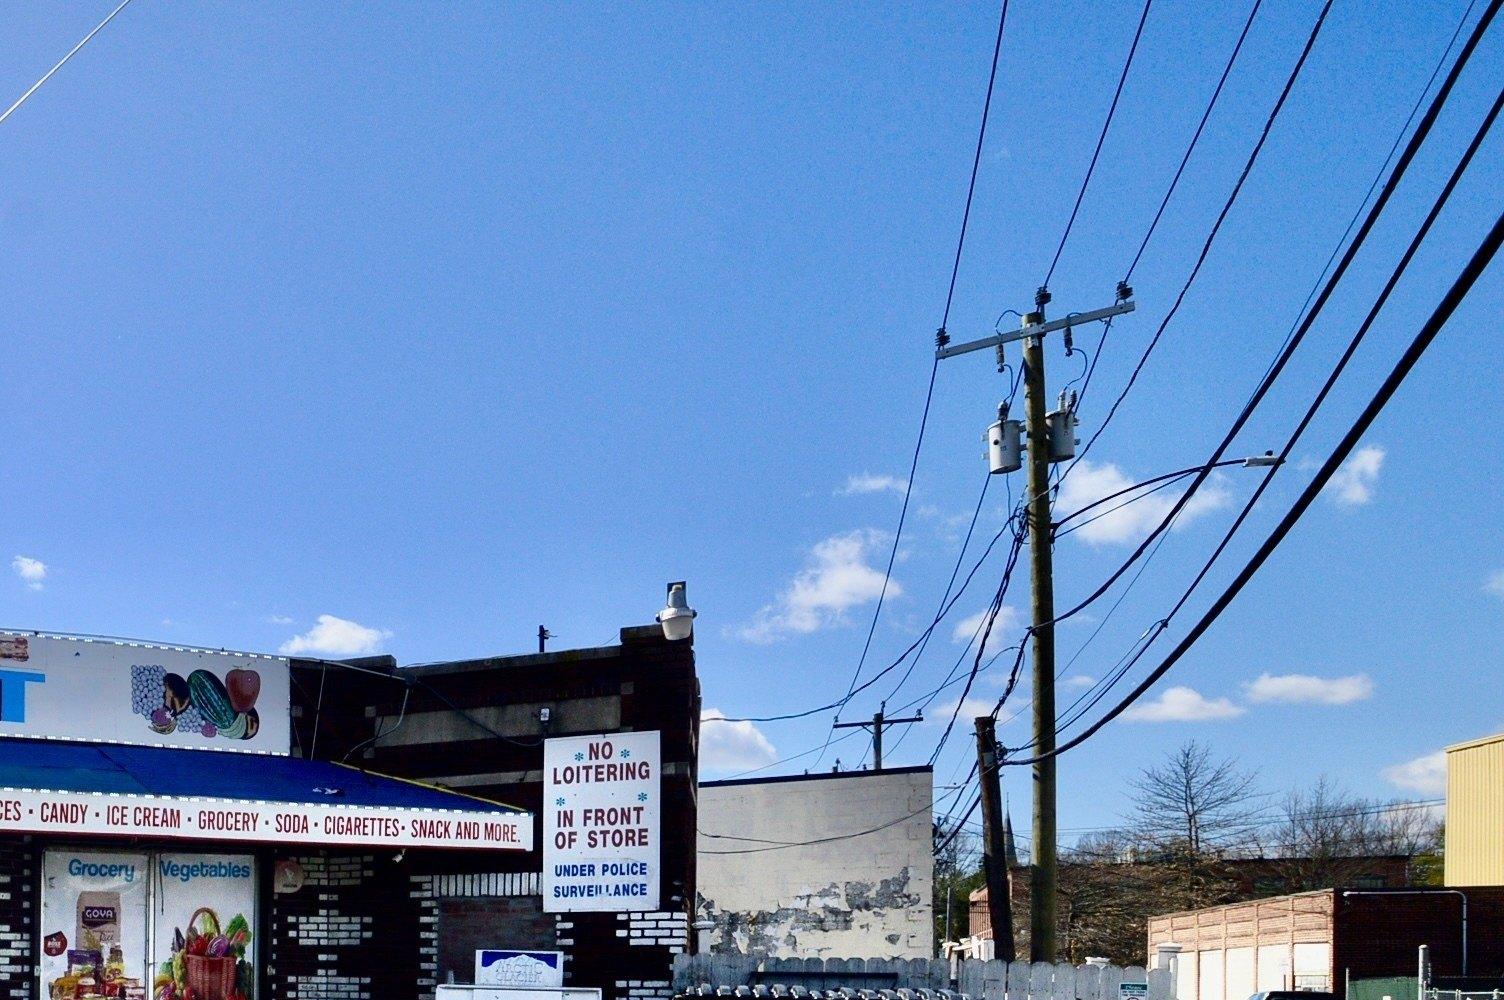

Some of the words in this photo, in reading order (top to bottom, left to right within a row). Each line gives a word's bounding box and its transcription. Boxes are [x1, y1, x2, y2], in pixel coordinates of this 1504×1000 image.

[589, 742, 614, 761] NO
[553, 762, 651, 785] LOITERING
[40, 802, 88, 824] CANDY
[107, 805, 129, 826] ICE
[134, 807, 181, 828] CREAM
[198, 811, 259, 832] GROCERY
[557, 810, 573, 828] IN
[583, 807, 644, 827] FRONT
[275, 814, 309, 834] SODA
[324, 816, 400, 837] CIGARETTES
[411, 820, 451, 840] SNACK
[455, 823, 480, 841] AND
[484, 823, 521, 843] MORE.
[555, 831, 578, 850] OF
[588, 828, 649, 849] STORE
[68, 858, 135, 882] Grocery
[160, 861, 251, 882] Vegetables
[555, 864, 596, 877] UNDER
[602, 863, 648, 876] POLICE
[553, 884, 648, 898] SURVEILLANCE
[86, 908, 114, 919] GOYA
